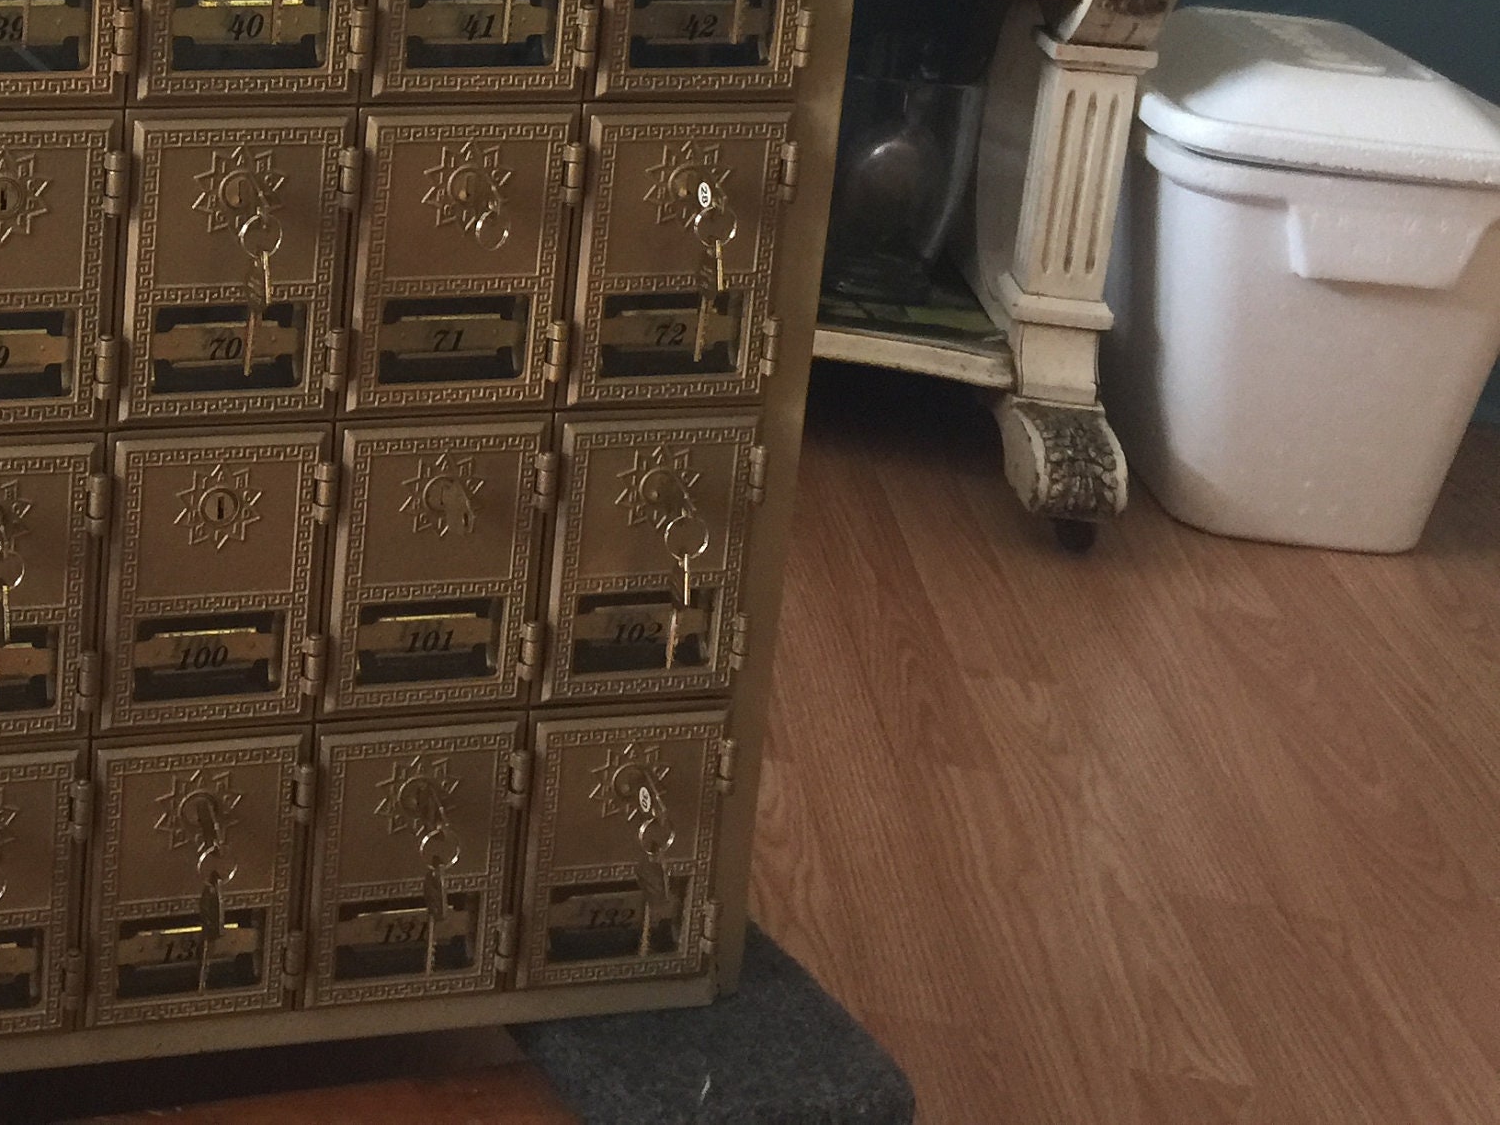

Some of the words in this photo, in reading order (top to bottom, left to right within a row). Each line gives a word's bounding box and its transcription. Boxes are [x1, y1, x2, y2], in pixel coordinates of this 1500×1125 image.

[226, 14, 265, 40] 40
[462, 14, 497, 40] 41
[682, 14, 718, 40] 42
[431, 329, 466, 352] 71
[653, 322, 687, 346] 72
[209, 337, 243, 361] 70
[407, 629, 454, 653] 101
[612, 622, 662, 644] 102
[174, 646, 229, 671] 100
[379, 921, 430, 945] 131
[161, 939, 198, 964] 13
